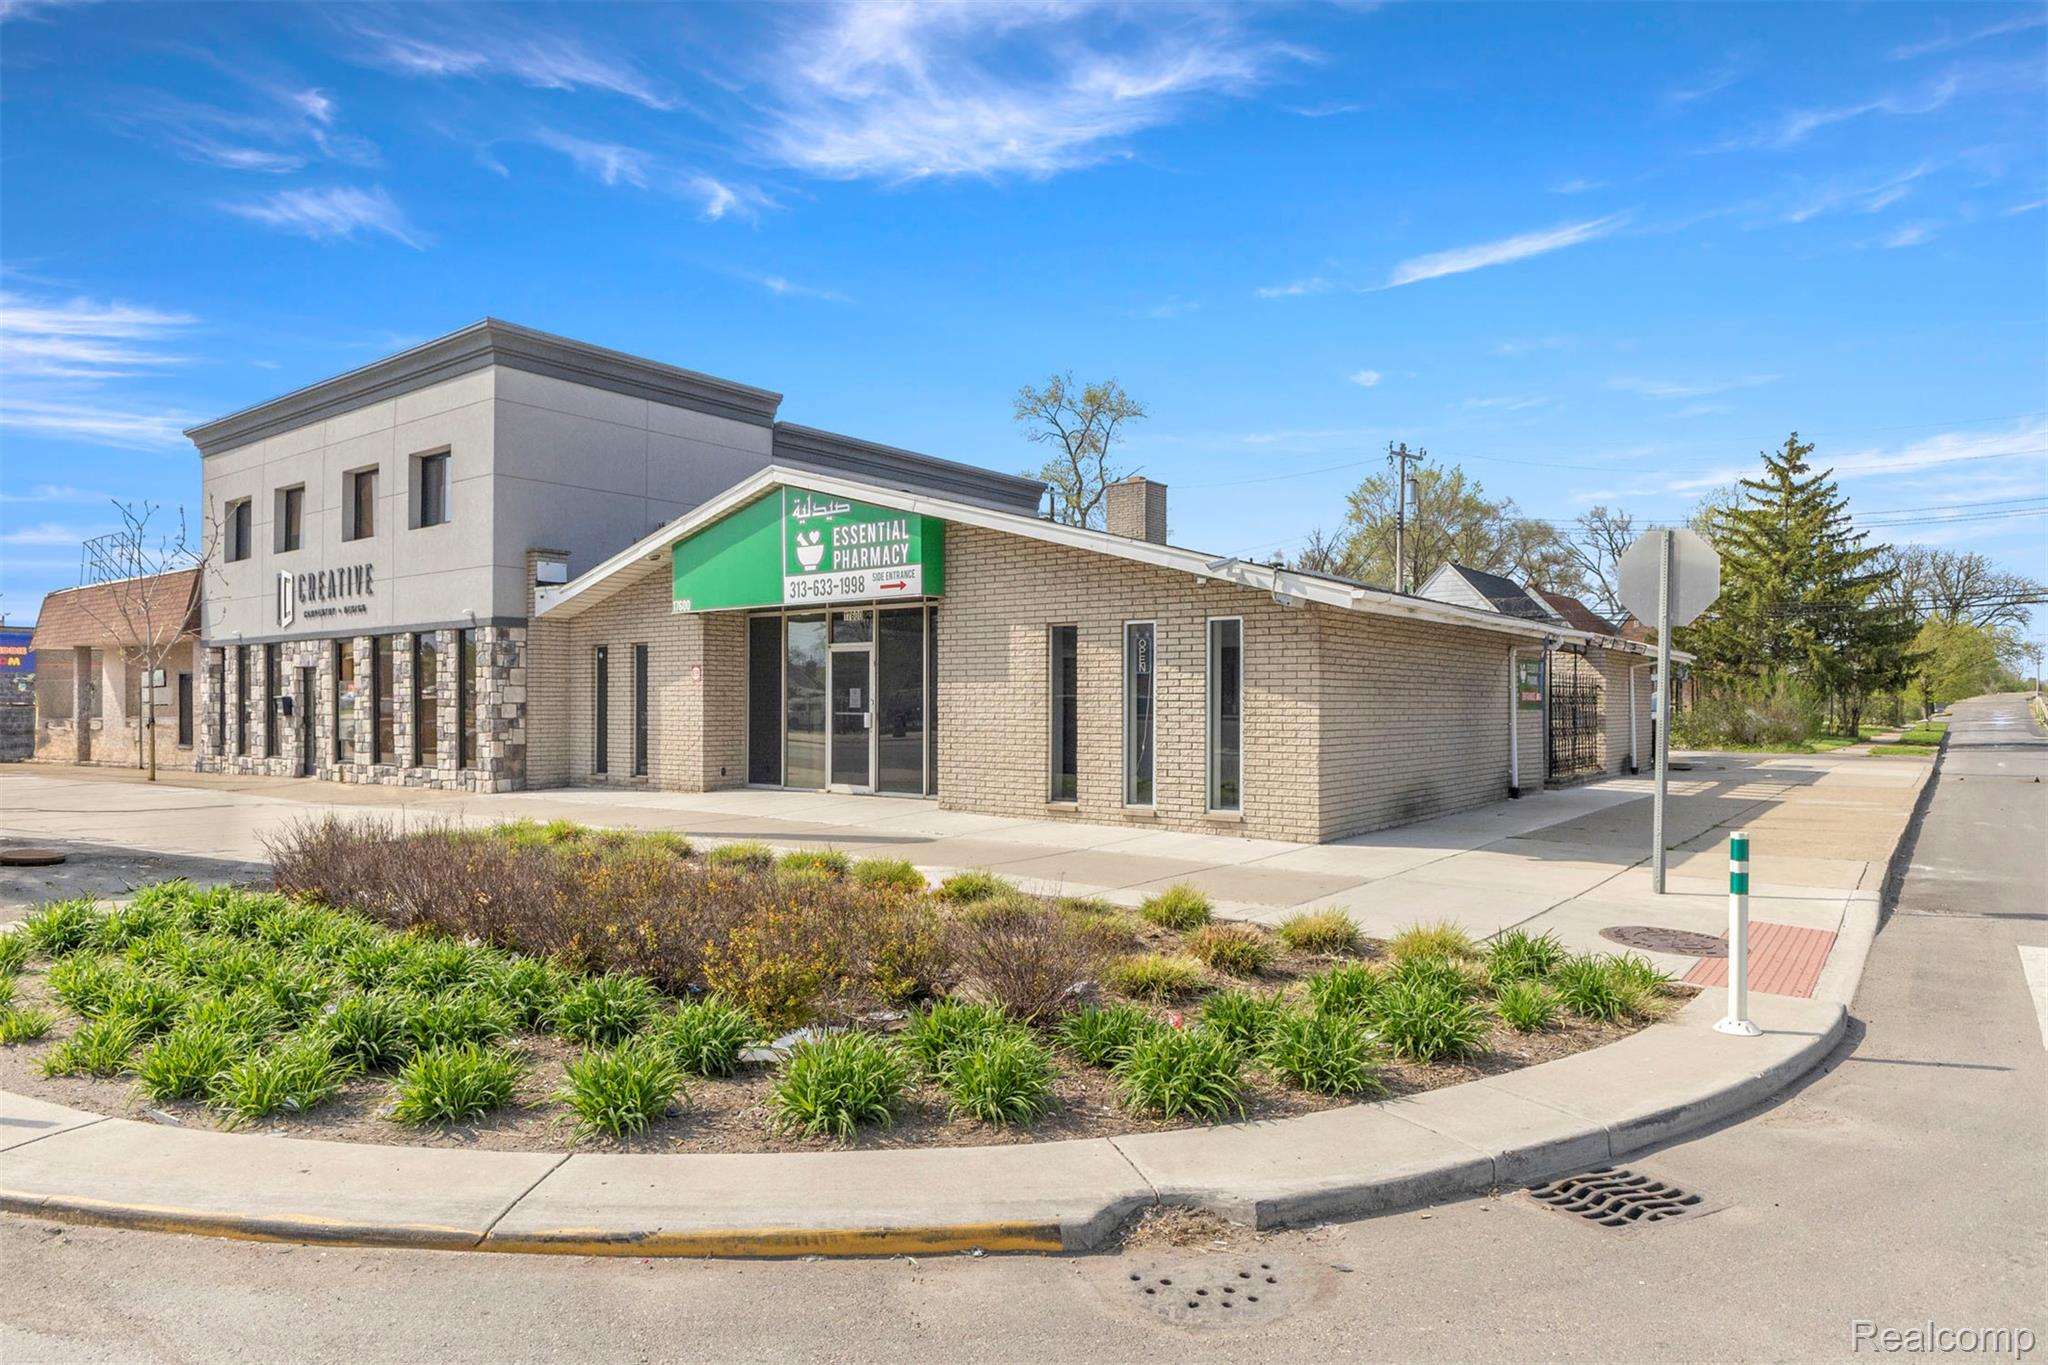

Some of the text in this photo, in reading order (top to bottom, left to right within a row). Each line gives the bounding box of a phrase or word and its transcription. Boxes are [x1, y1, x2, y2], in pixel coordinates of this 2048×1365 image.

[792, 494, 850, 525] صيدلية
[833, 520, 909, 546] ESSENTIAL
[833, 544, 909, 570] PHARMACY
[298, 563, 374, 604] CREATIVE
[790, 575, 865, 599] 313-633-1998
[872, 569, 916, 582] SIDE ENTRANCE
[1138, 639, 1147, 672] OPEN
